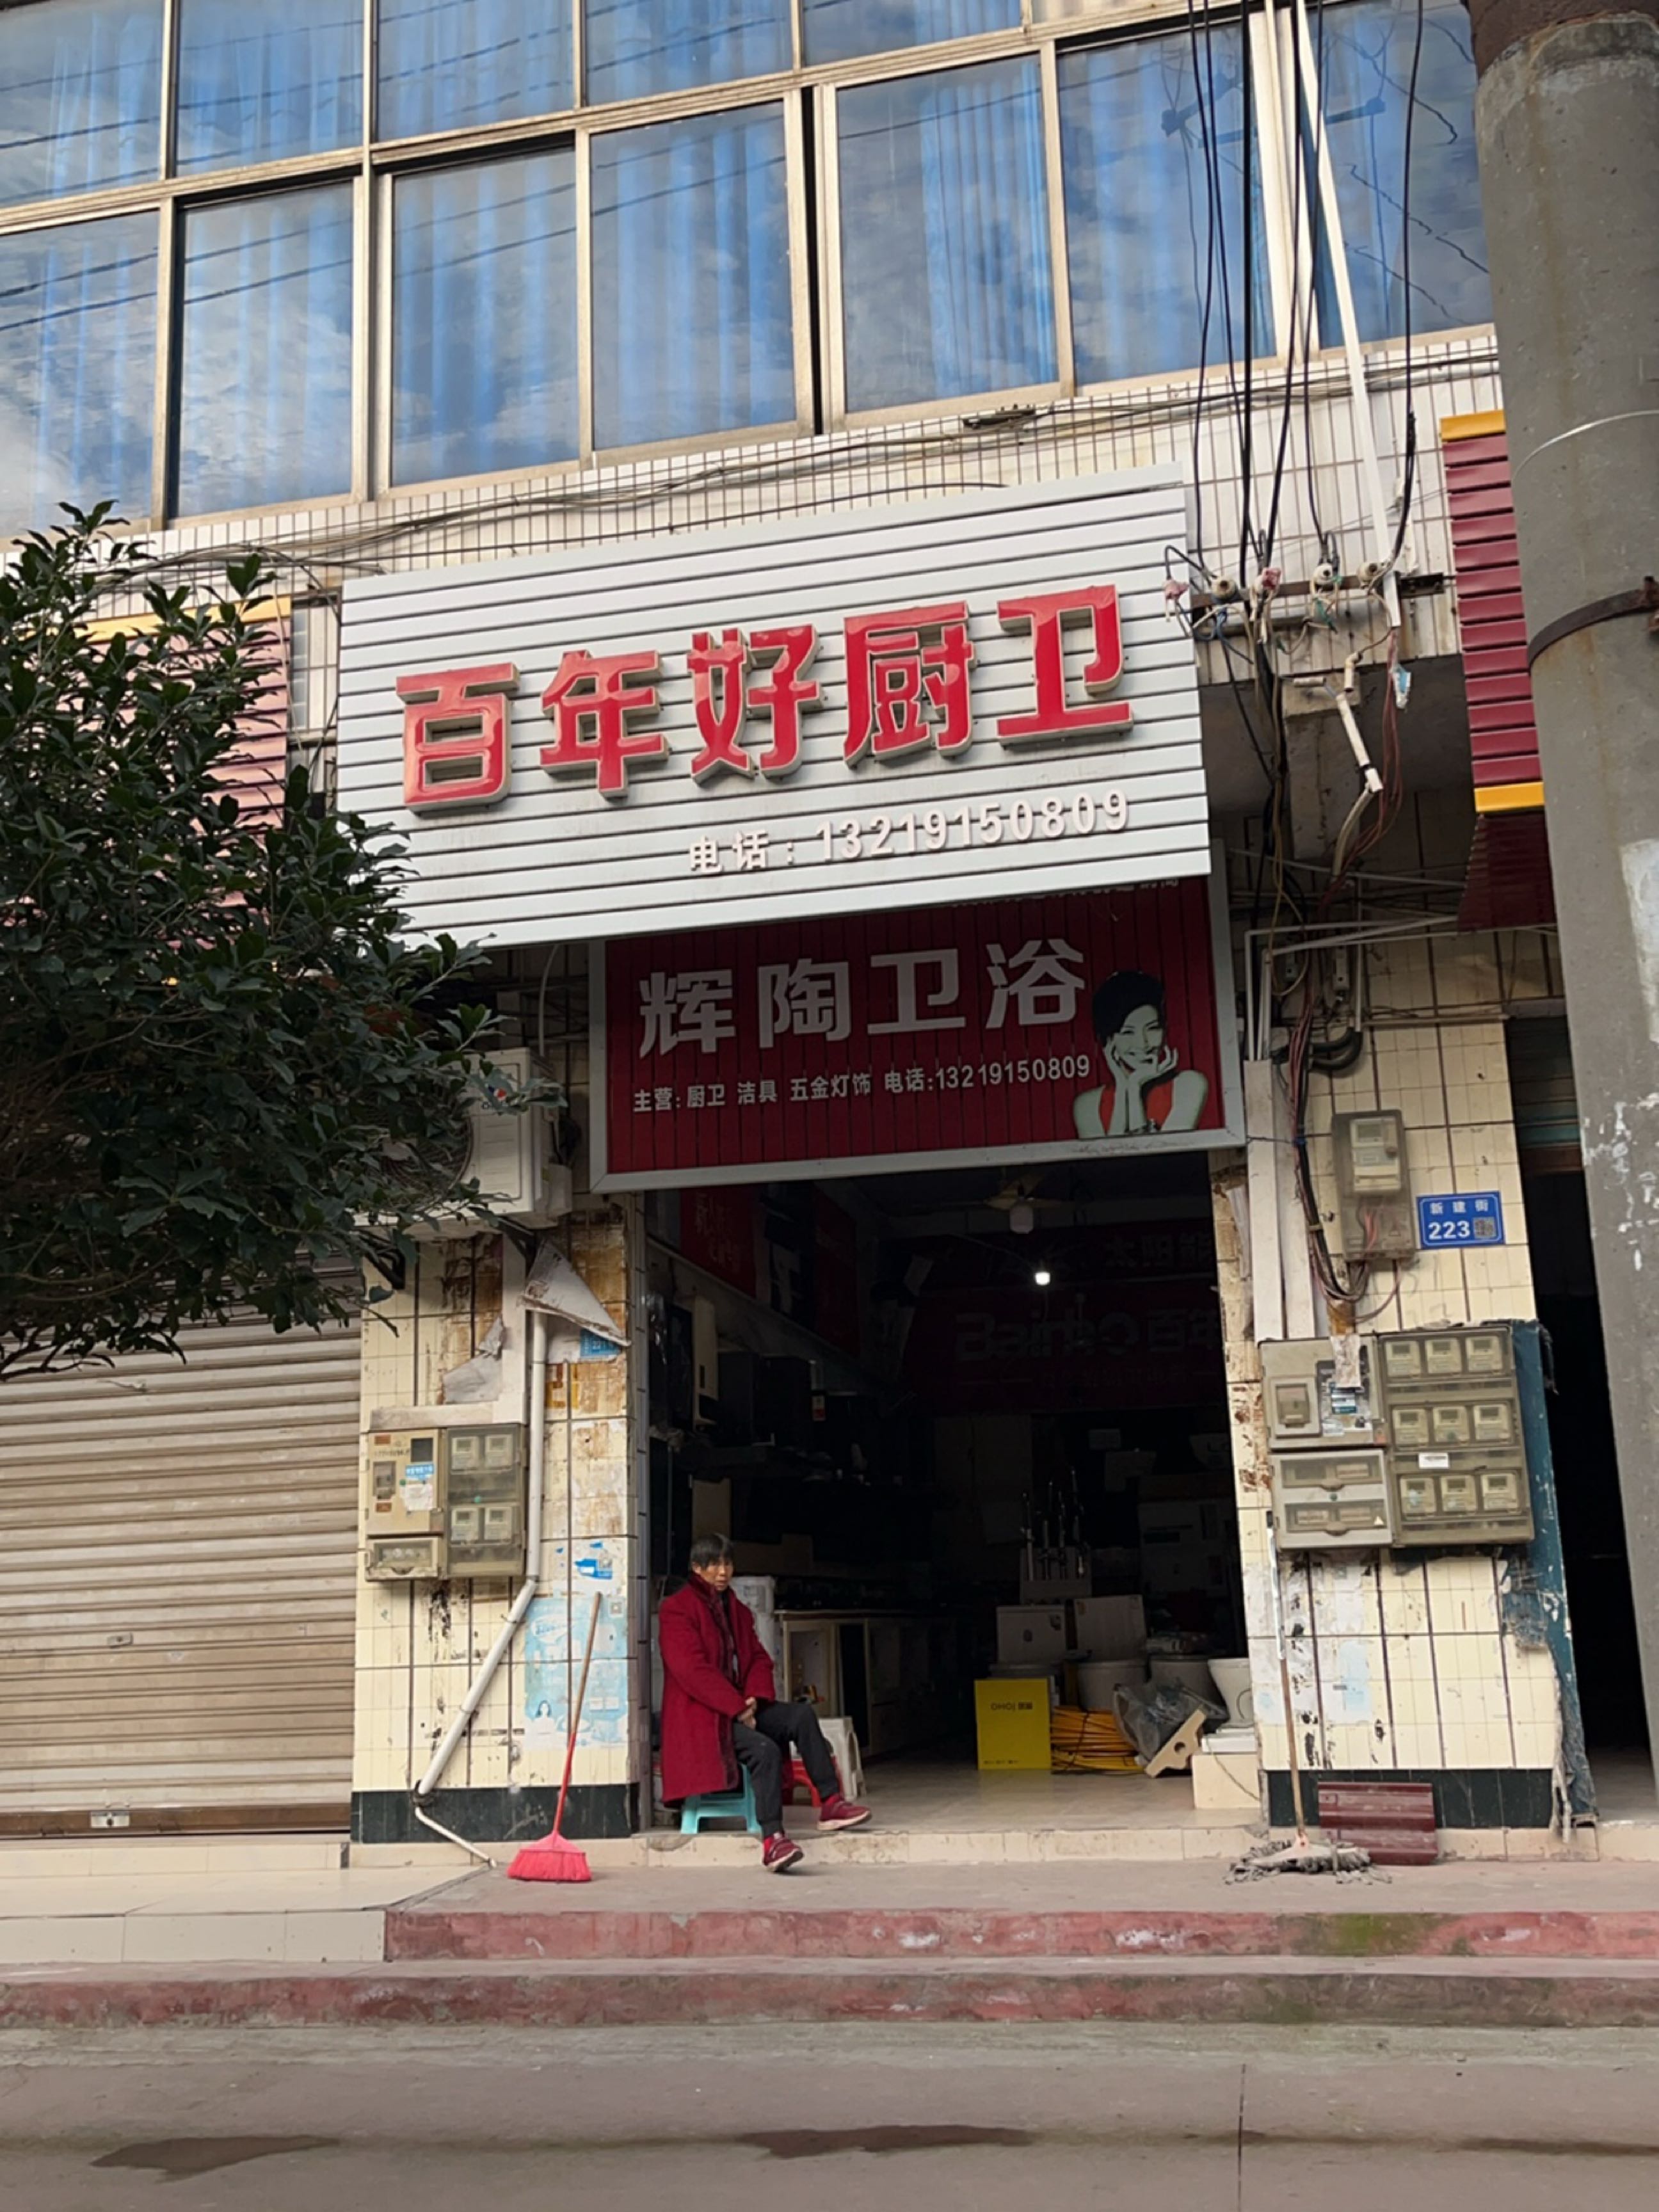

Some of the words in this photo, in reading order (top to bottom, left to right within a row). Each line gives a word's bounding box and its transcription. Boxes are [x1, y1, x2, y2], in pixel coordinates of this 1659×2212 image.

[395, 584, 1134, 812] 百年好厨卫
[639, 939, 1085, 1059] 辉陶卫浴
[790, 1073, 872, 1102] 五金灯饰
[1428, 1220, 1471, 1240] 223
